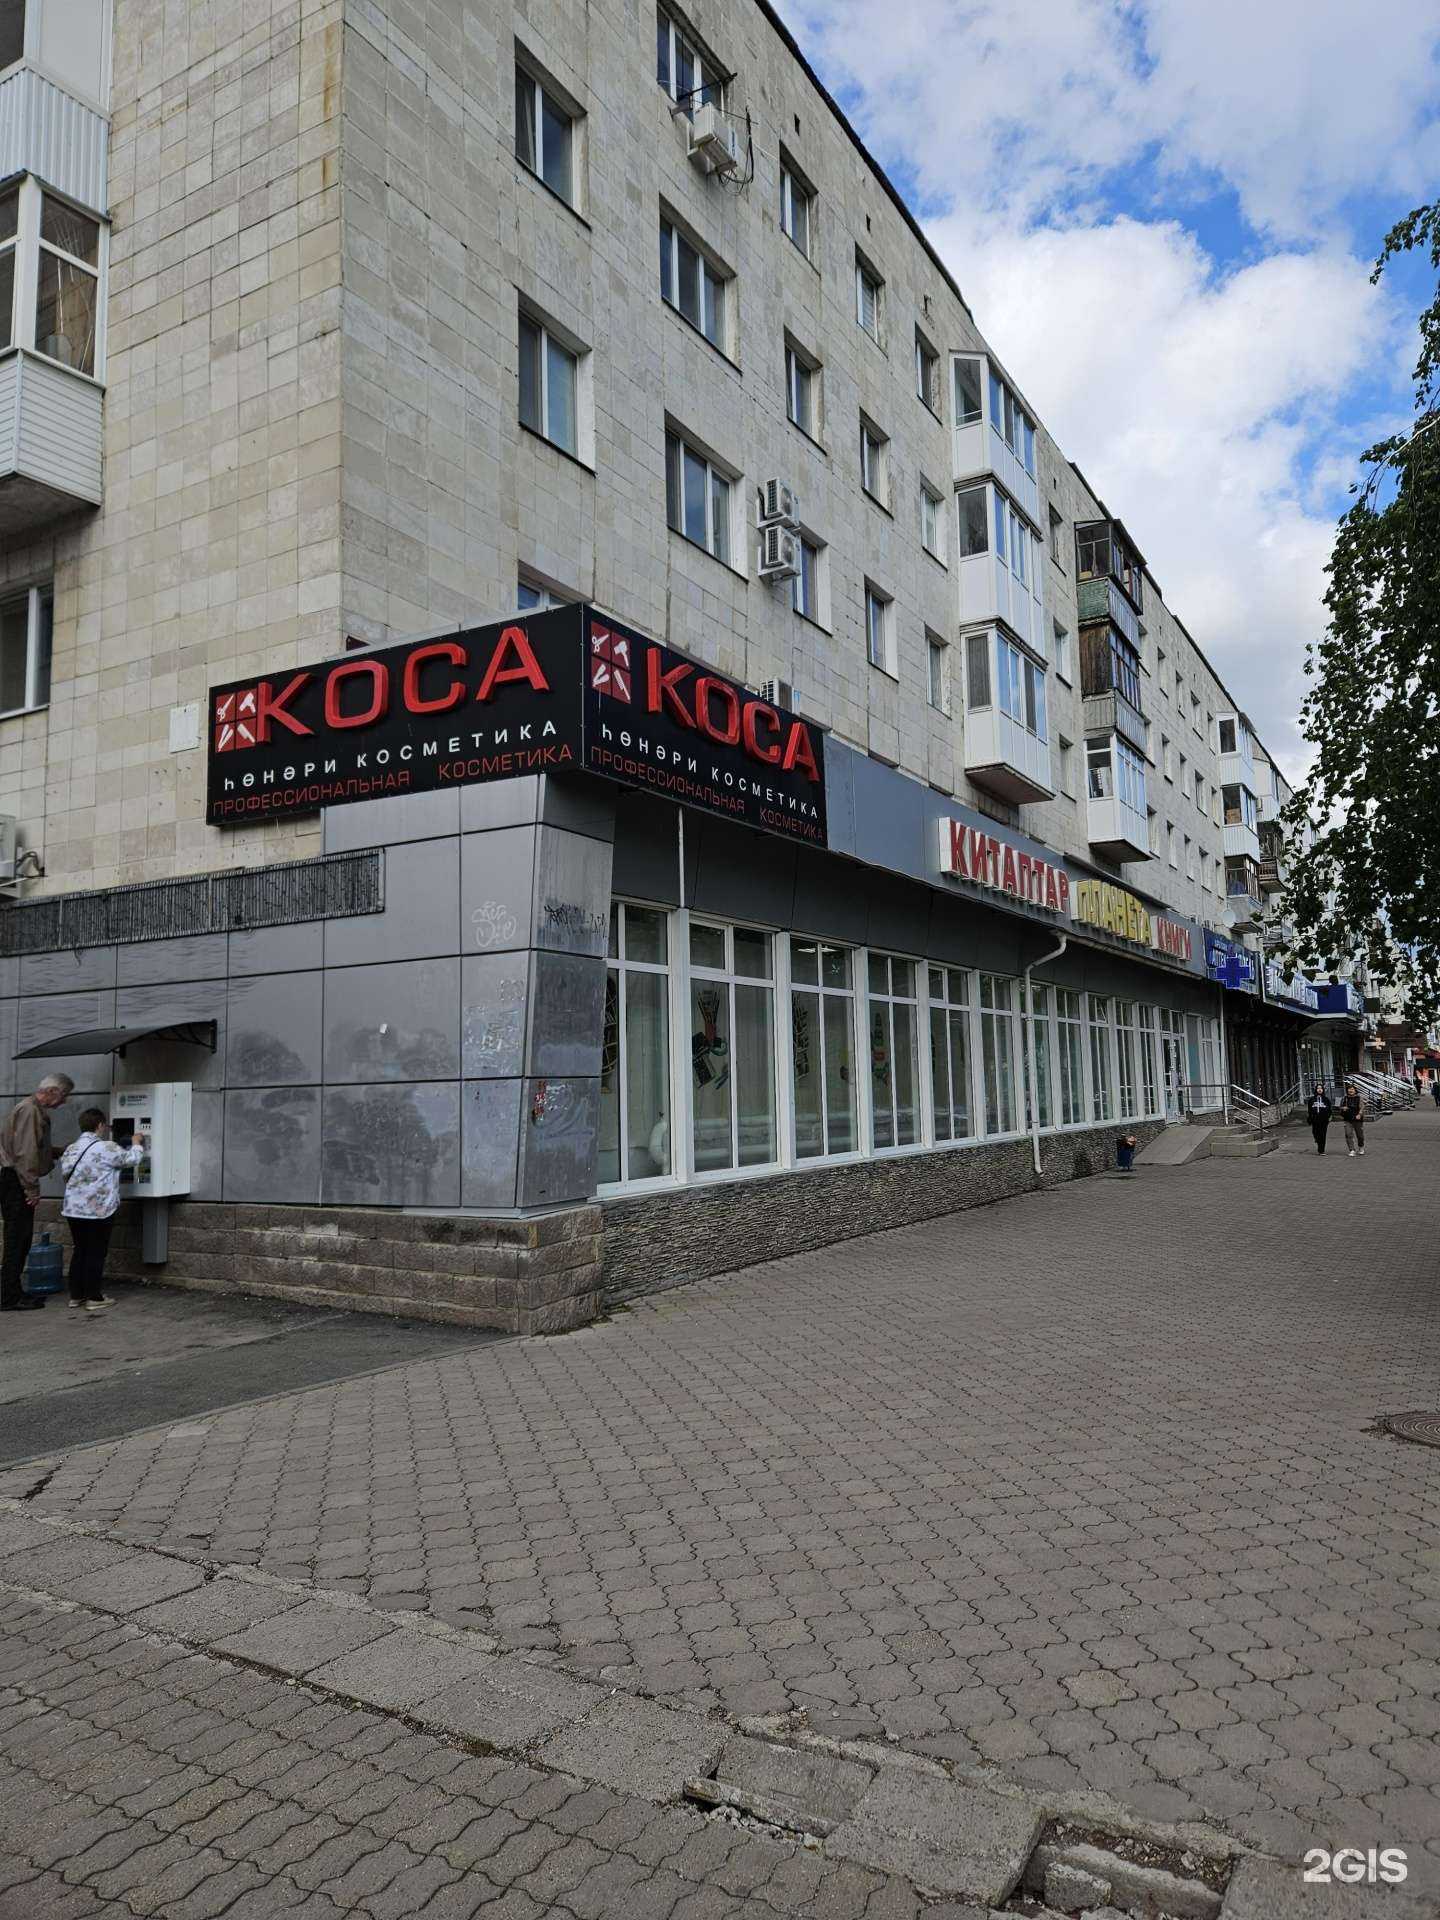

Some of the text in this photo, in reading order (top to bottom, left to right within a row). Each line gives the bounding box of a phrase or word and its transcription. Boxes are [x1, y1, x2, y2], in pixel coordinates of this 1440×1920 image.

[256, 626, 550, 744] КОСА
[647, 647, 820, 782] КОСА
[213, 744, 573, 816] ПРОФЕССИОНАЛЬНАЯ КОСМЕТИКА
[357, 720, 557, 769] КОСМЕТИКА
[591, 746, 824, 840] ПРОФЕССИОНАЛЬНАЯ КОСМЕТИКА
[712, 767, 818, 818] КОСМЕТИКА
[945, 819, 1070, 913] КИТАПТАР
[1076, 879, 1152, 947] ПЛАНЕТА
